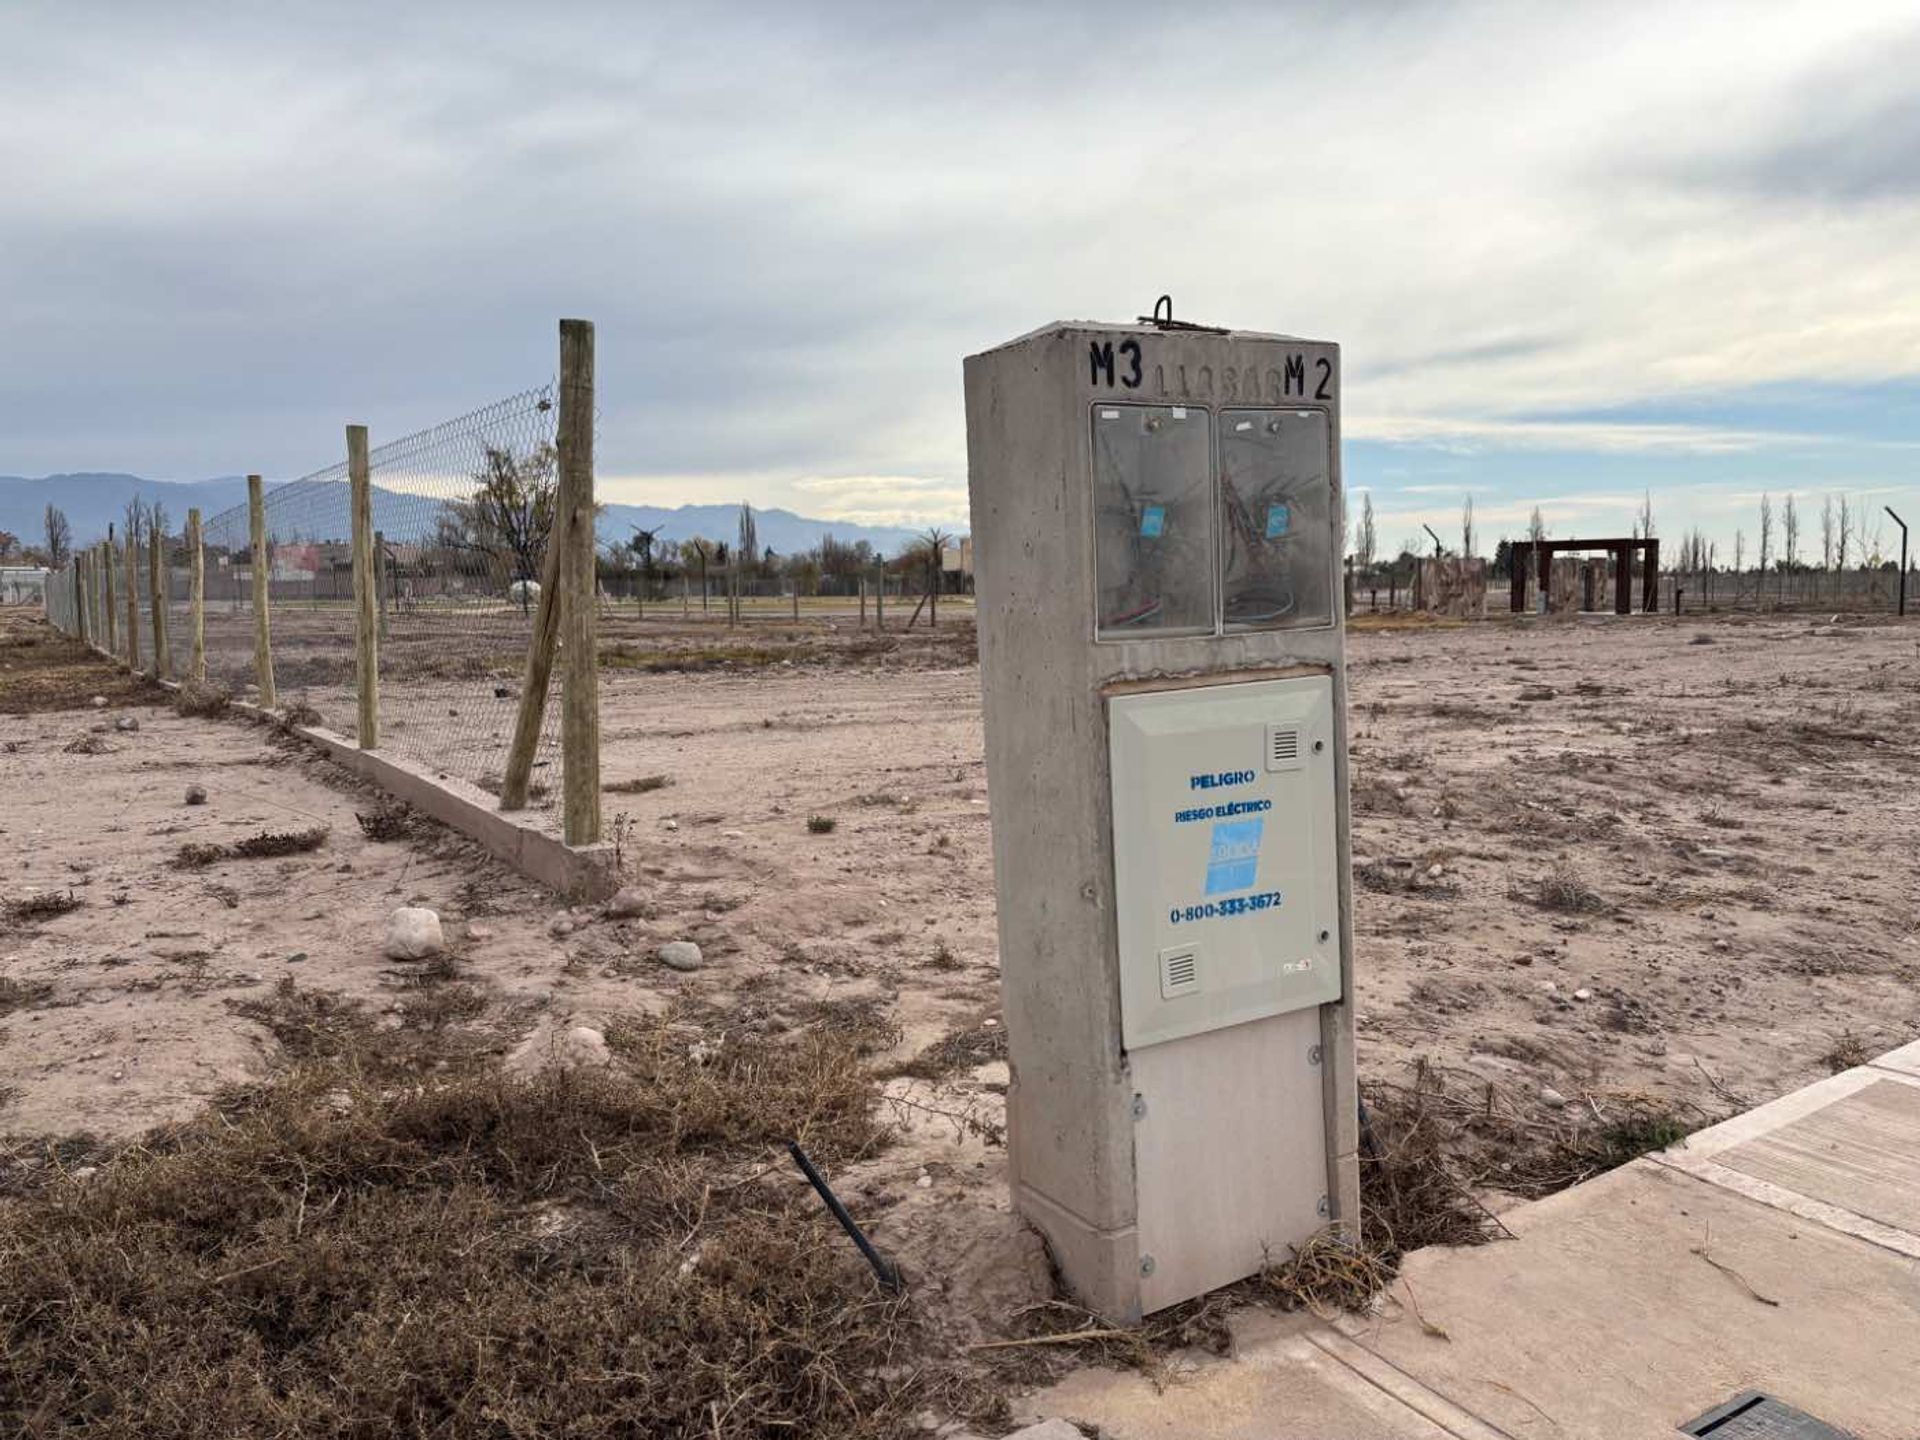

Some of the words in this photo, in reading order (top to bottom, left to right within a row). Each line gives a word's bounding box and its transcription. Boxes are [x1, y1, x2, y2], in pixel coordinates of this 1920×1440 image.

[1089, 339, 1143, 389] M3
[1191, 770, 1255, 790] PELIGRO
[1175, 807, 1214, 823] RIESGO
[1215, 799, 1273, 818] ELÉCTRICO
[1170, 892, 1282, 923] 0-800-333-3672
